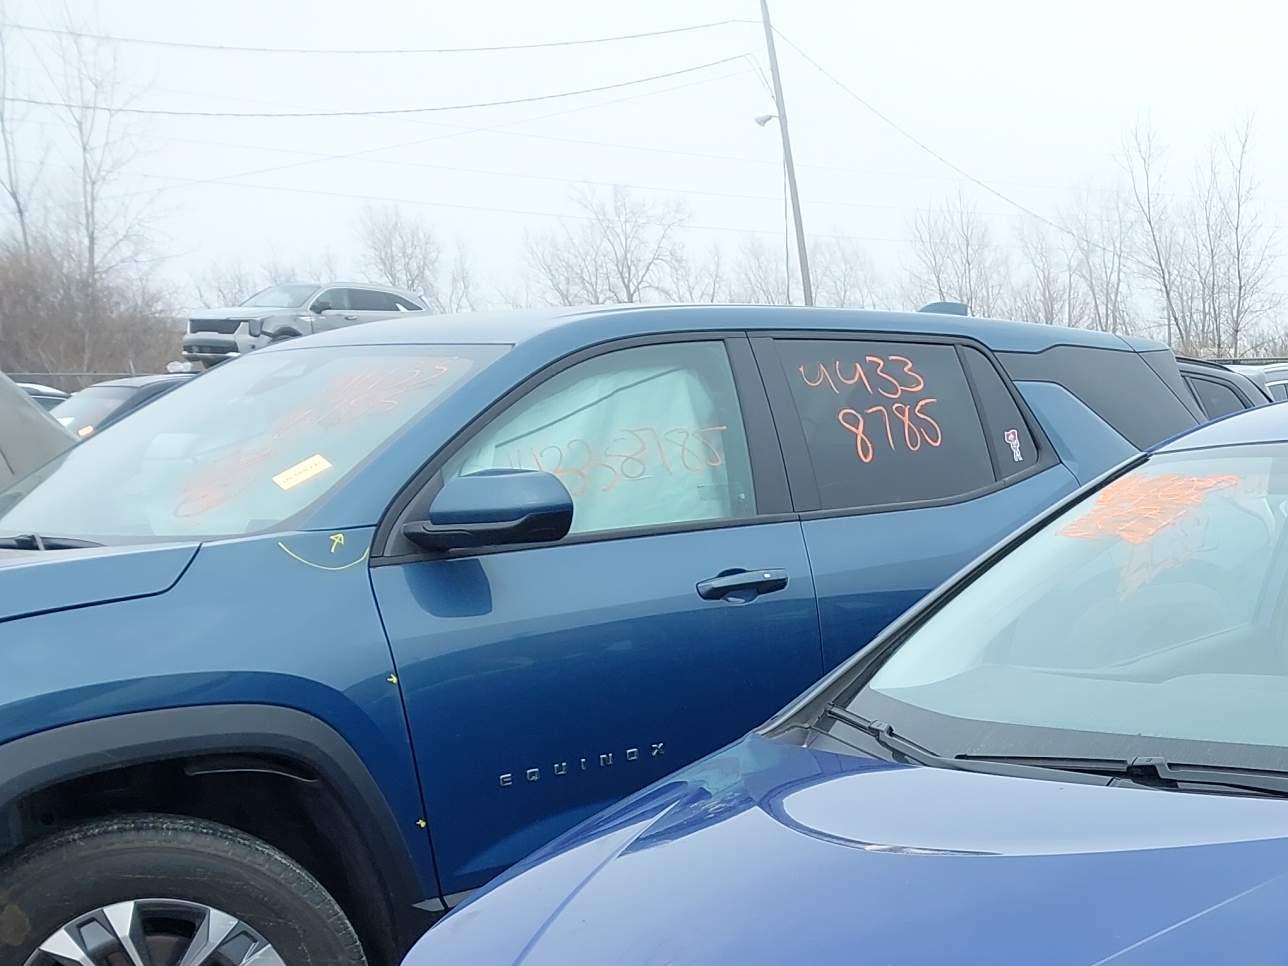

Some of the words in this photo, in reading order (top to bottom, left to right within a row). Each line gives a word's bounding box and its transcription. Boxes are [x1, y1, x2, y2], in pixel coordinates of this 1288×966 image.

[799, 355, 925, 399] 4433
[838, 398, 943, 464] 8785
[499, 742, 664, 786] EQUINOX
